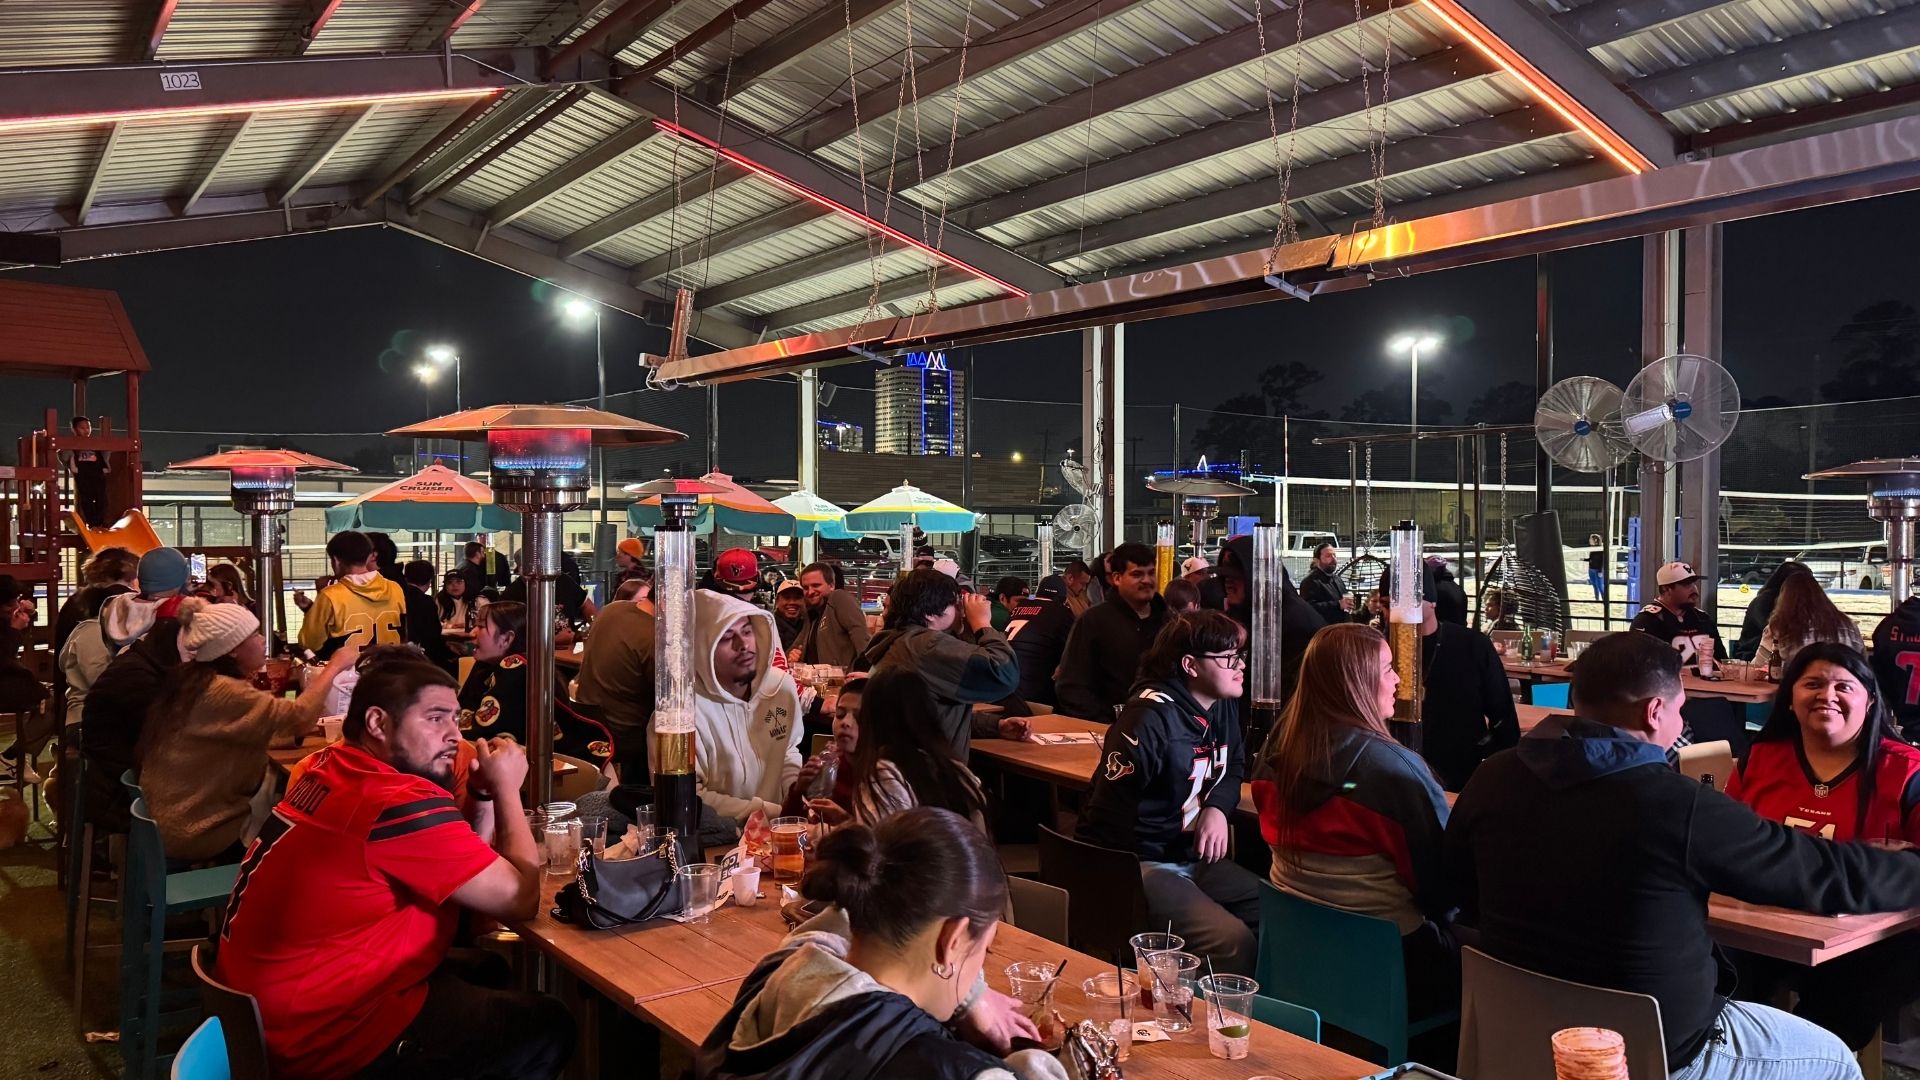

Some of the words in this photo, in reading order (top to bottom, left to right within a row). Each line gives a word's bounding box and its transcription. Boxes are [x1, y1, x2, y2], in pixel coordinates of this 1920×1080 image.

[162, 73, 200, 89] 1023
[1010, 605, 1043, 618] STROUD
[343, 610, 402, 654] 26
[1004, 618, 1031, 642] 7
[1798, 806, 1832, 816] TEXANS
